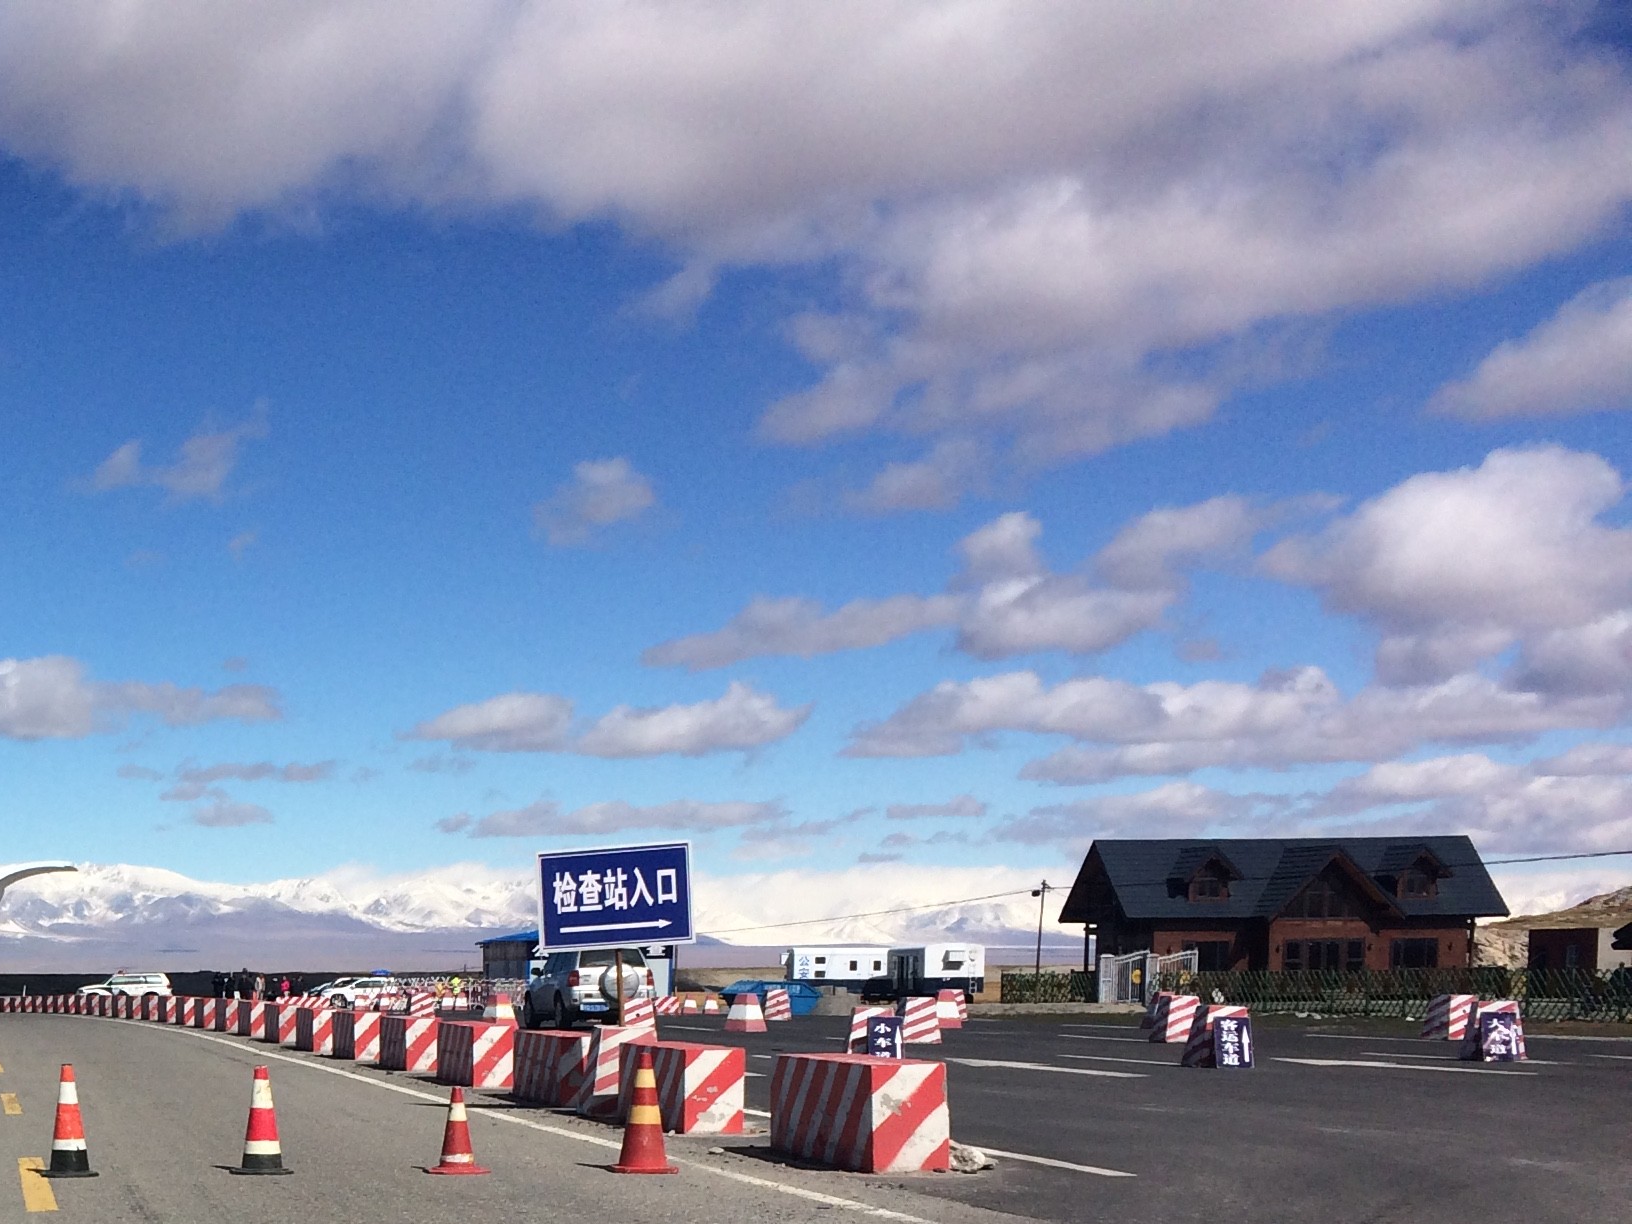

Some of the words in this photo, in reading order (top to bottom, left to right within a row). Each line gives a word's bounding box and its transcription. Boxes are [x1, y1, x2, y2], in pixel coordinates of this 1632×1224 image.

[552, 867, 678, 914] 检查站入口
[798, 956, 810, 980] 公安
[1220, 1019, 1240, 1066] 客运车道
